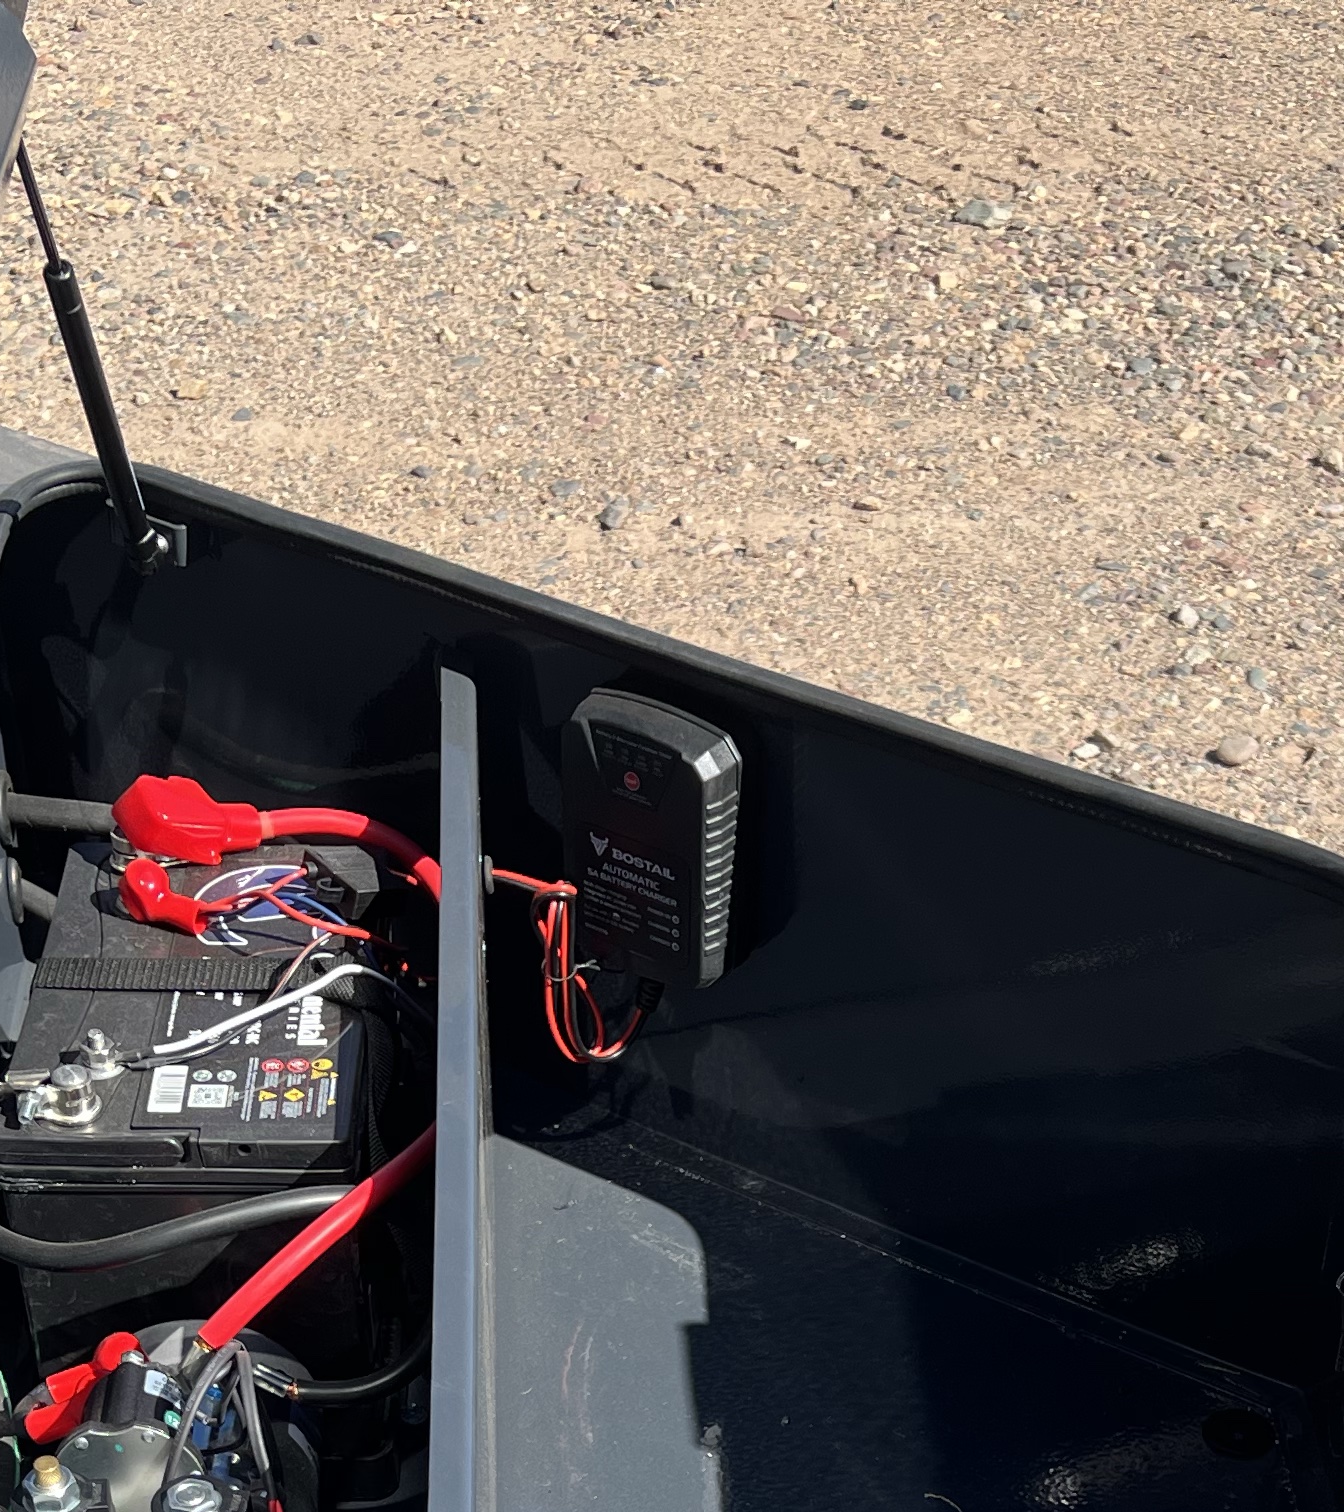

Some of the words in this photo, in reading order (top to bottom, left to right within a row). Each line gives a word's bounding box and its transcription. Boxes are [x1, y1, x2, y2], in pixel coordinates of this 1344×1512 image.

[602, 861, 661, 892] AUTOMATIC
[611, 847, 676, 881] BOSTAIL
[599, 871, 637, 891] BATTERY
[637, 886, 678, 908] CHARGER
